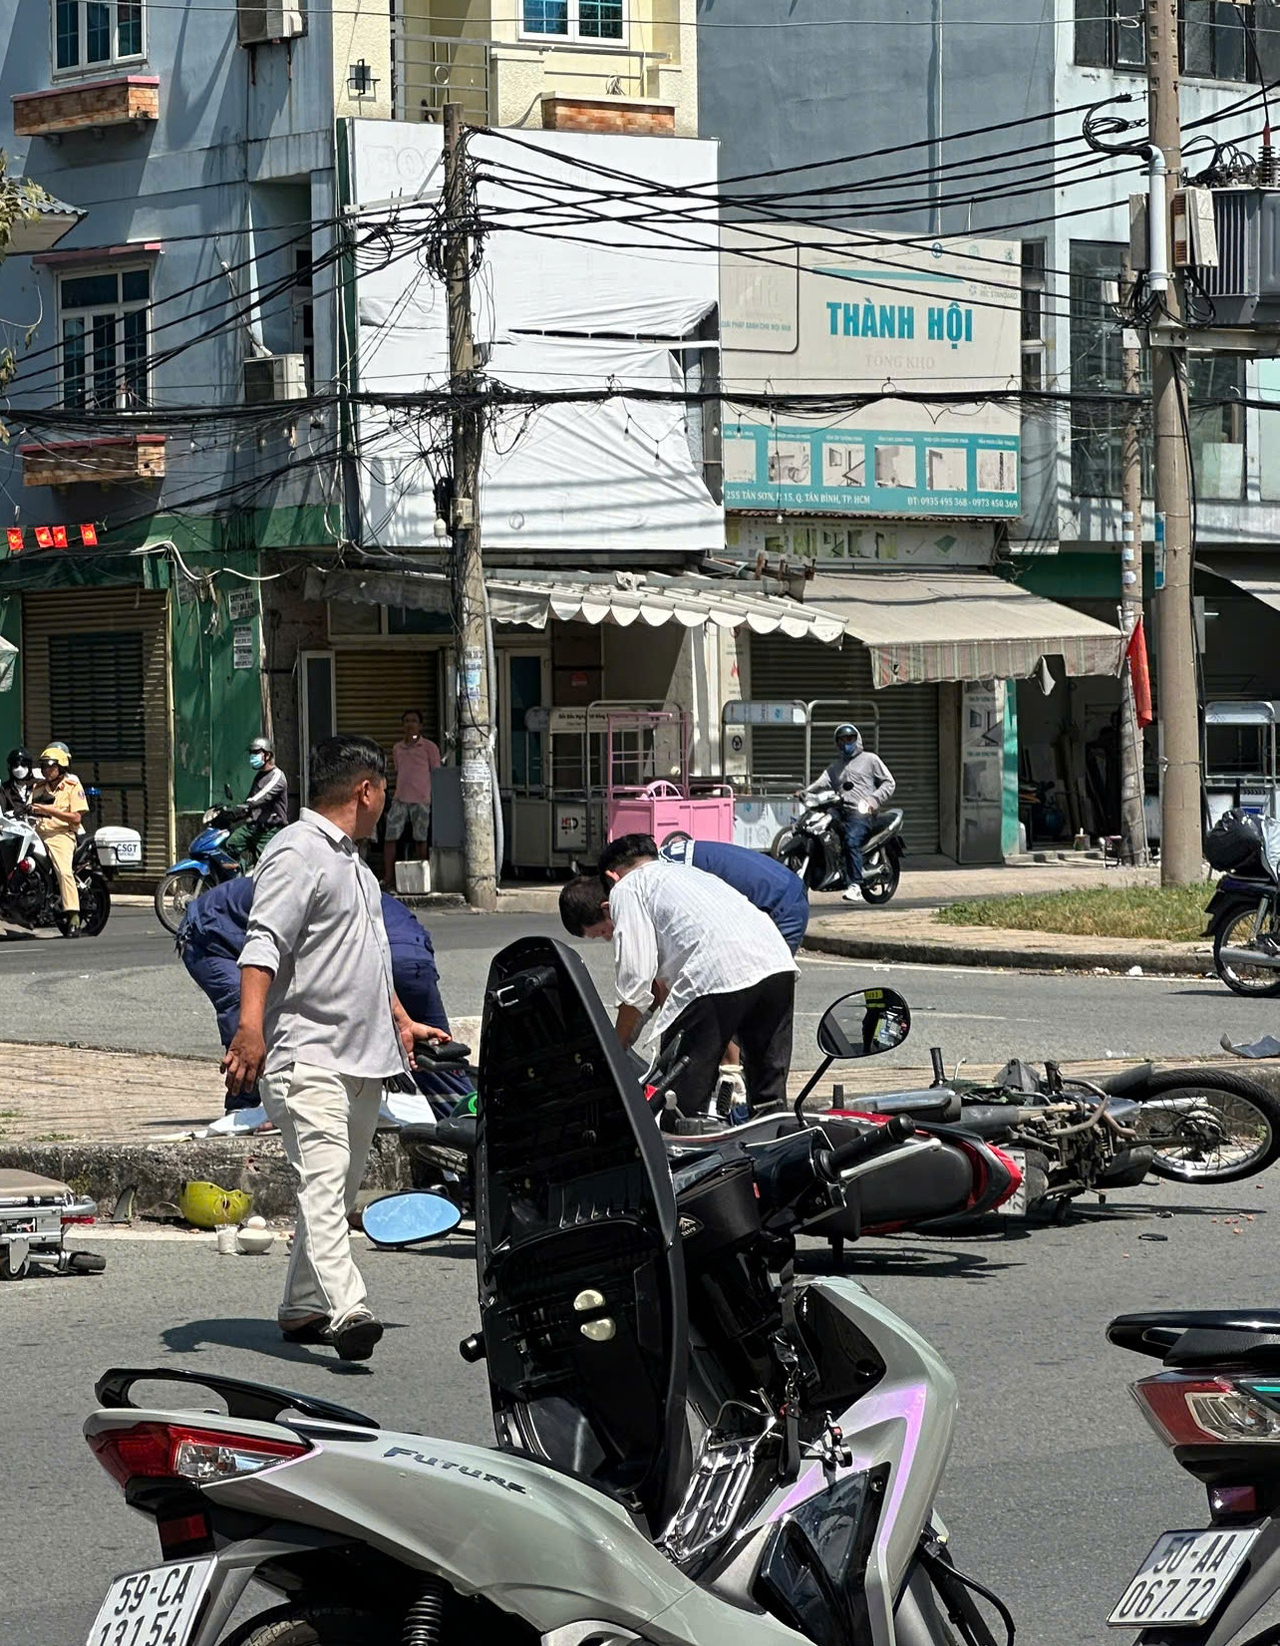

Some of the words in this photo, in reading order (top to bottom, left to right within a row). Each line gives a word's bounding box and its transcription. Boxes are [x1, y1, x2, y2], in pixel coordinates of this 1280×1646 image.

[826, 297, 914, 340] THÀNH
[928, 299, 973, 349] HỘI
[726, 490, 740, 500] 255
[742, 489, 756, 500] TÂN
[805, 491, 819, 502] TÂN
[920, 496, 939, 506] 0935
[972, 498, 990, 508] 0973
[1005, 500, 1018, 509] 369
[381, 1446, 527, 1495] FUTURE
[1153, 1533, 1238, 1574] 50-AA
[114, 1564, 195, 1616] 59-CA
[1118, 1577, 1217, 1618] 067.72
